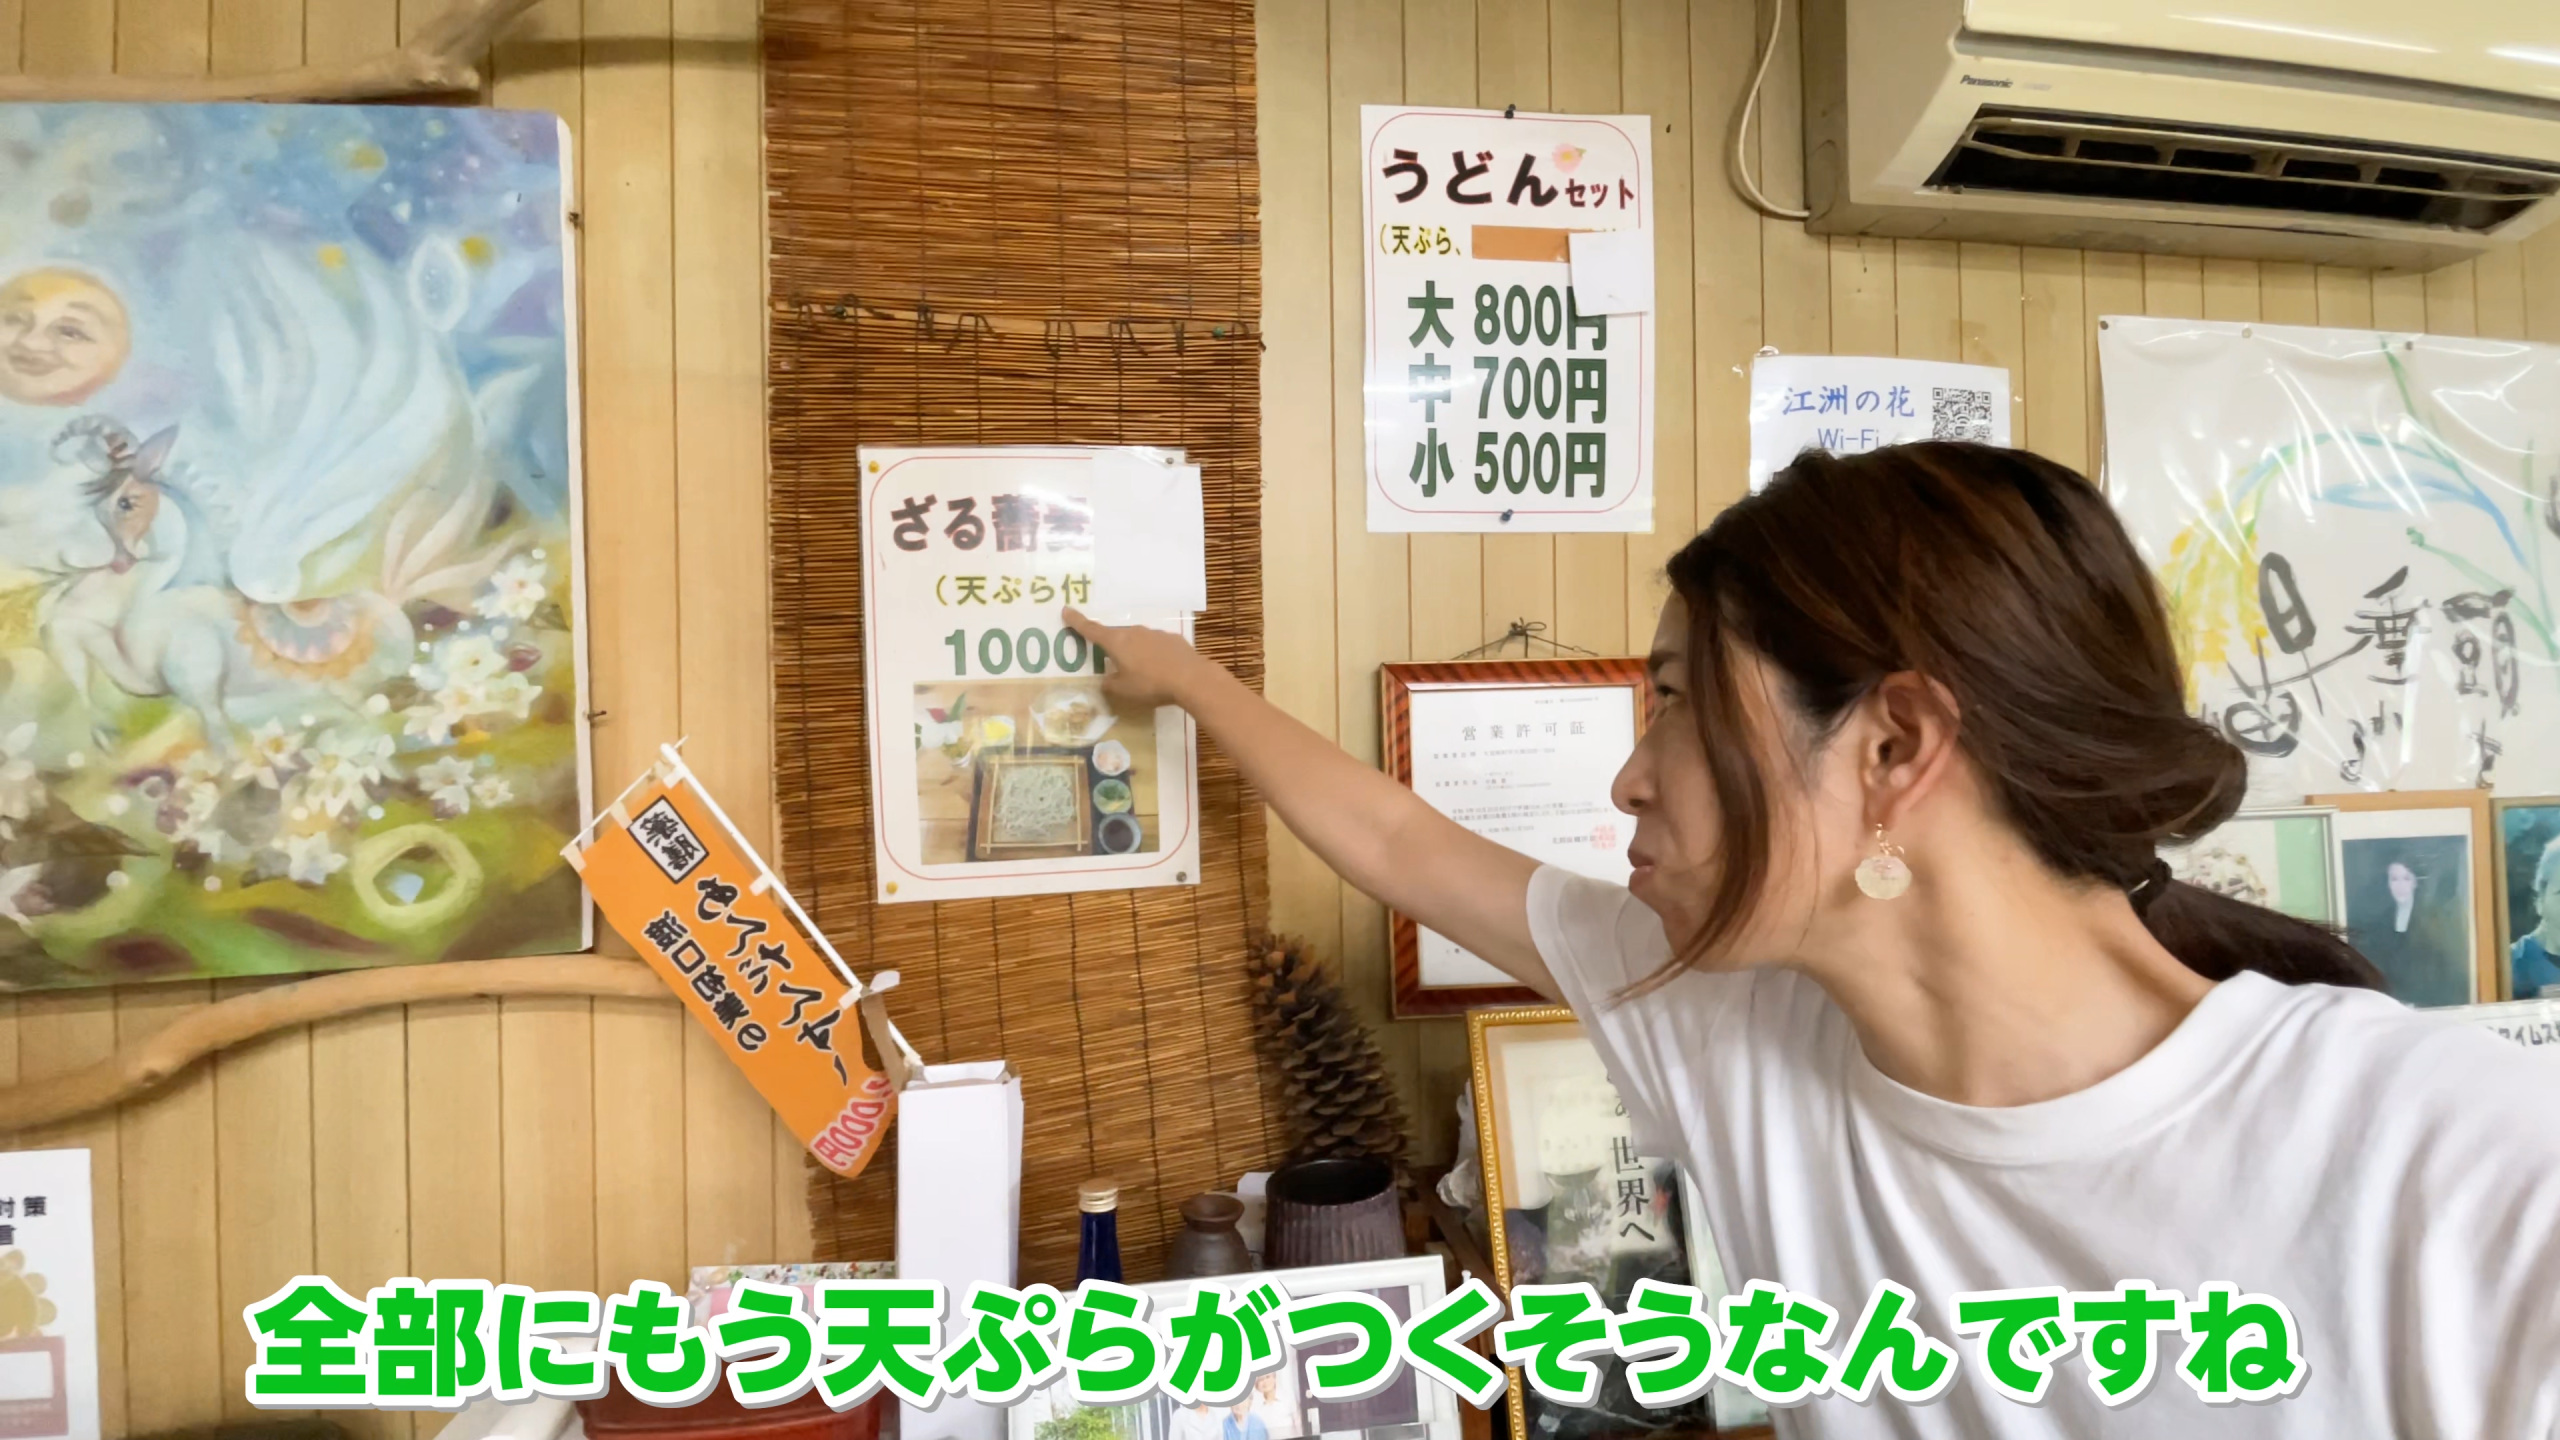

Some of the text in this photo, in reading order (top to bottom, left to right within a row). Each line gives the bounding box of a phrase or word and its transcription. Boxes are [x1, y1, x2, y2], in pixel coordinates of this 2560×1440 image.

[1960, 74, 2014, 89] Panasonic
[1408, 280, 1455, 349] 大
[1408, 354, 1608, 424] 中 700円
[1782, 384, 1915, 418] 江洲の花
[1817, 427, 1880, 450] Wi-Fi
[1408, 427, 1607, 499] 小 500円
[944, 626, 1108, 677] 1000
[1461, 720, 1586, 742] 営業許可証
